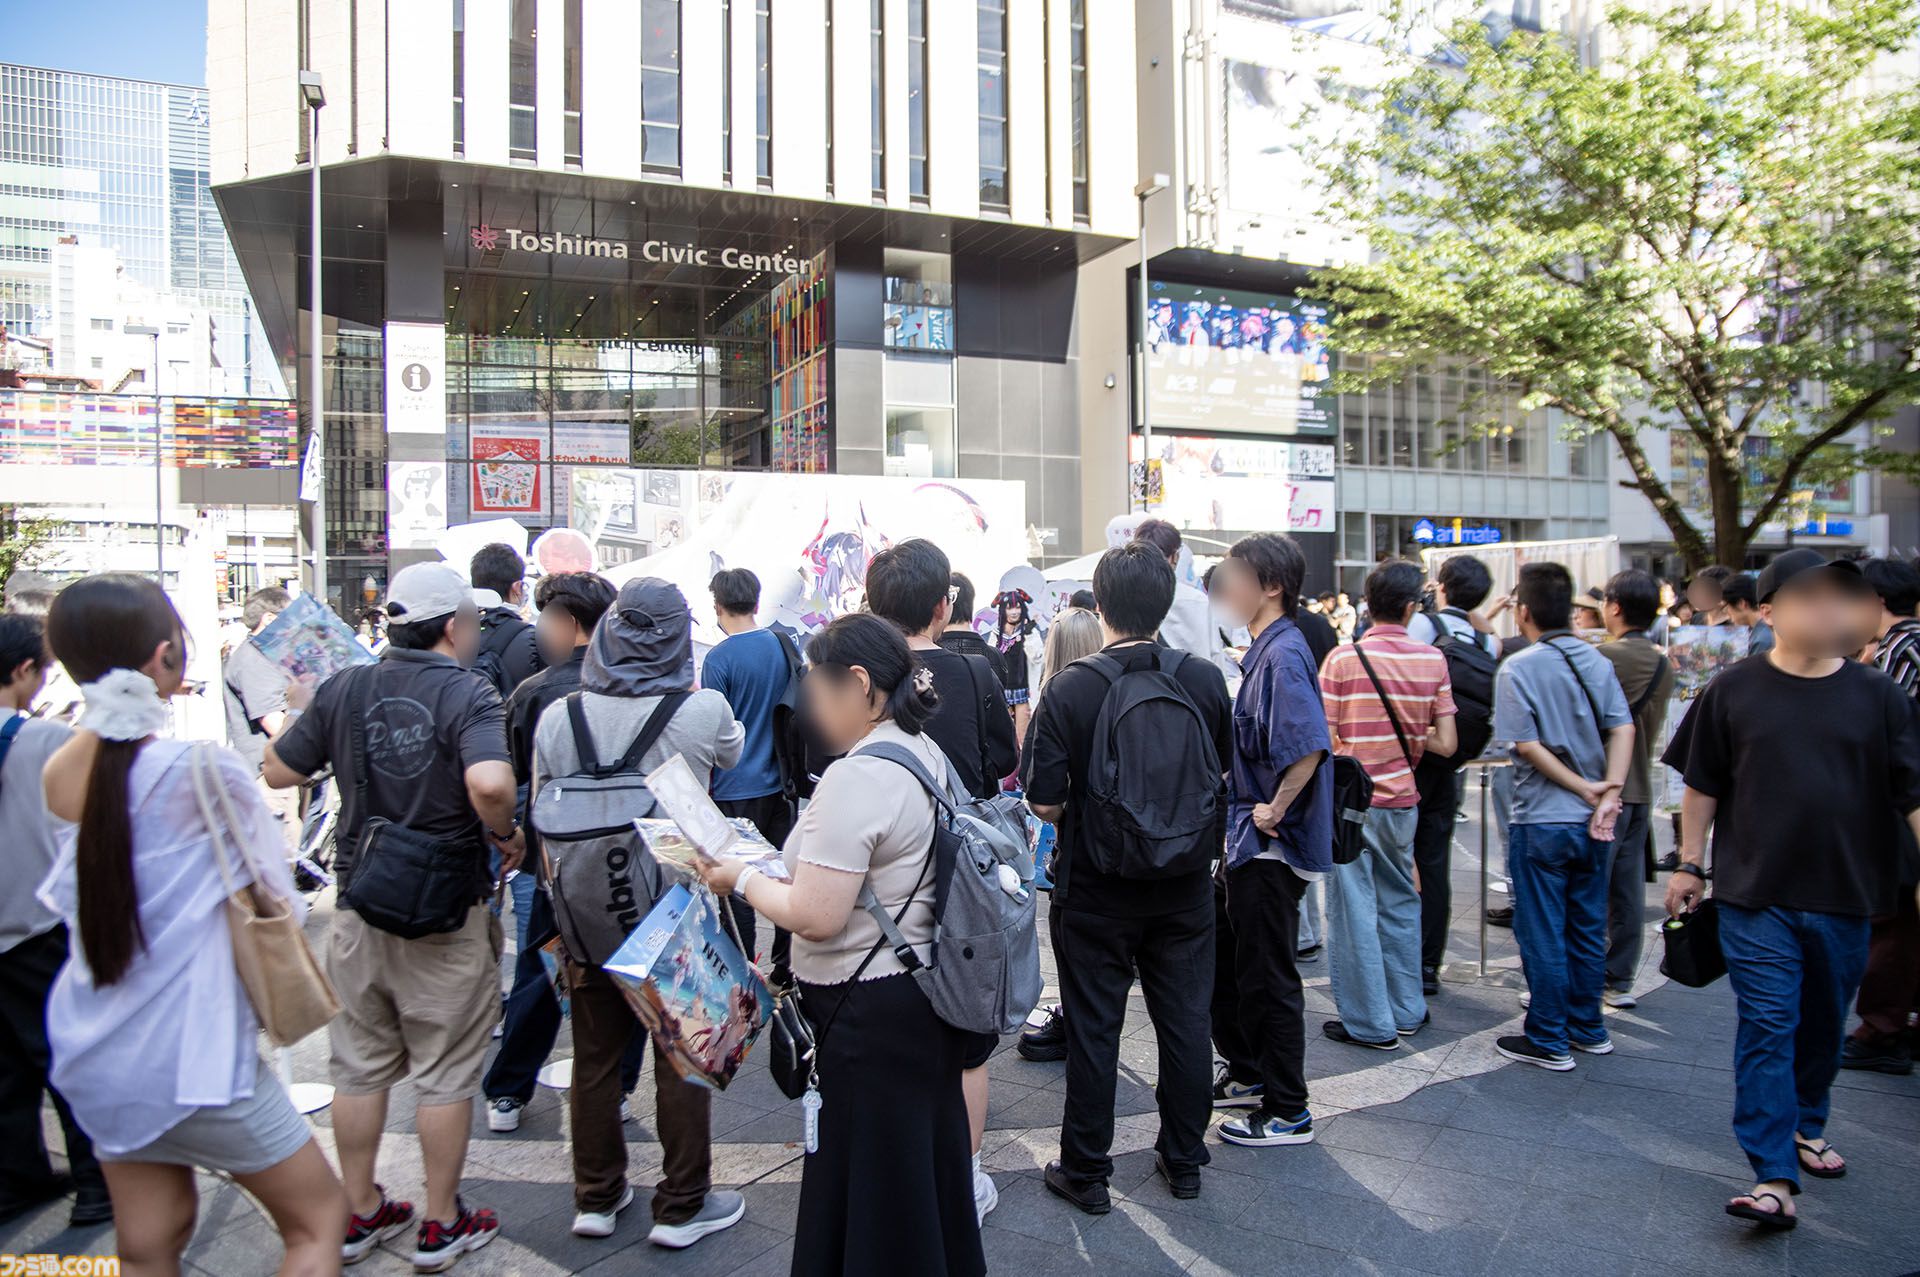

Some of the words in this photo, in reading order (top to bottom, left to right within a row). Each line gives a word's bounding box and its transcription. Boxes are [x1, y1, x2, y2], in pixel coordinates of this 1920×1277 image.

[505, 229, 629, 260] Toshima
[642, 240, 709, 266] Civic
[720, 247, 811, 275] Center
[1435, 517, 1501, 545] animate
[702, 941, 730, 981] NTE
